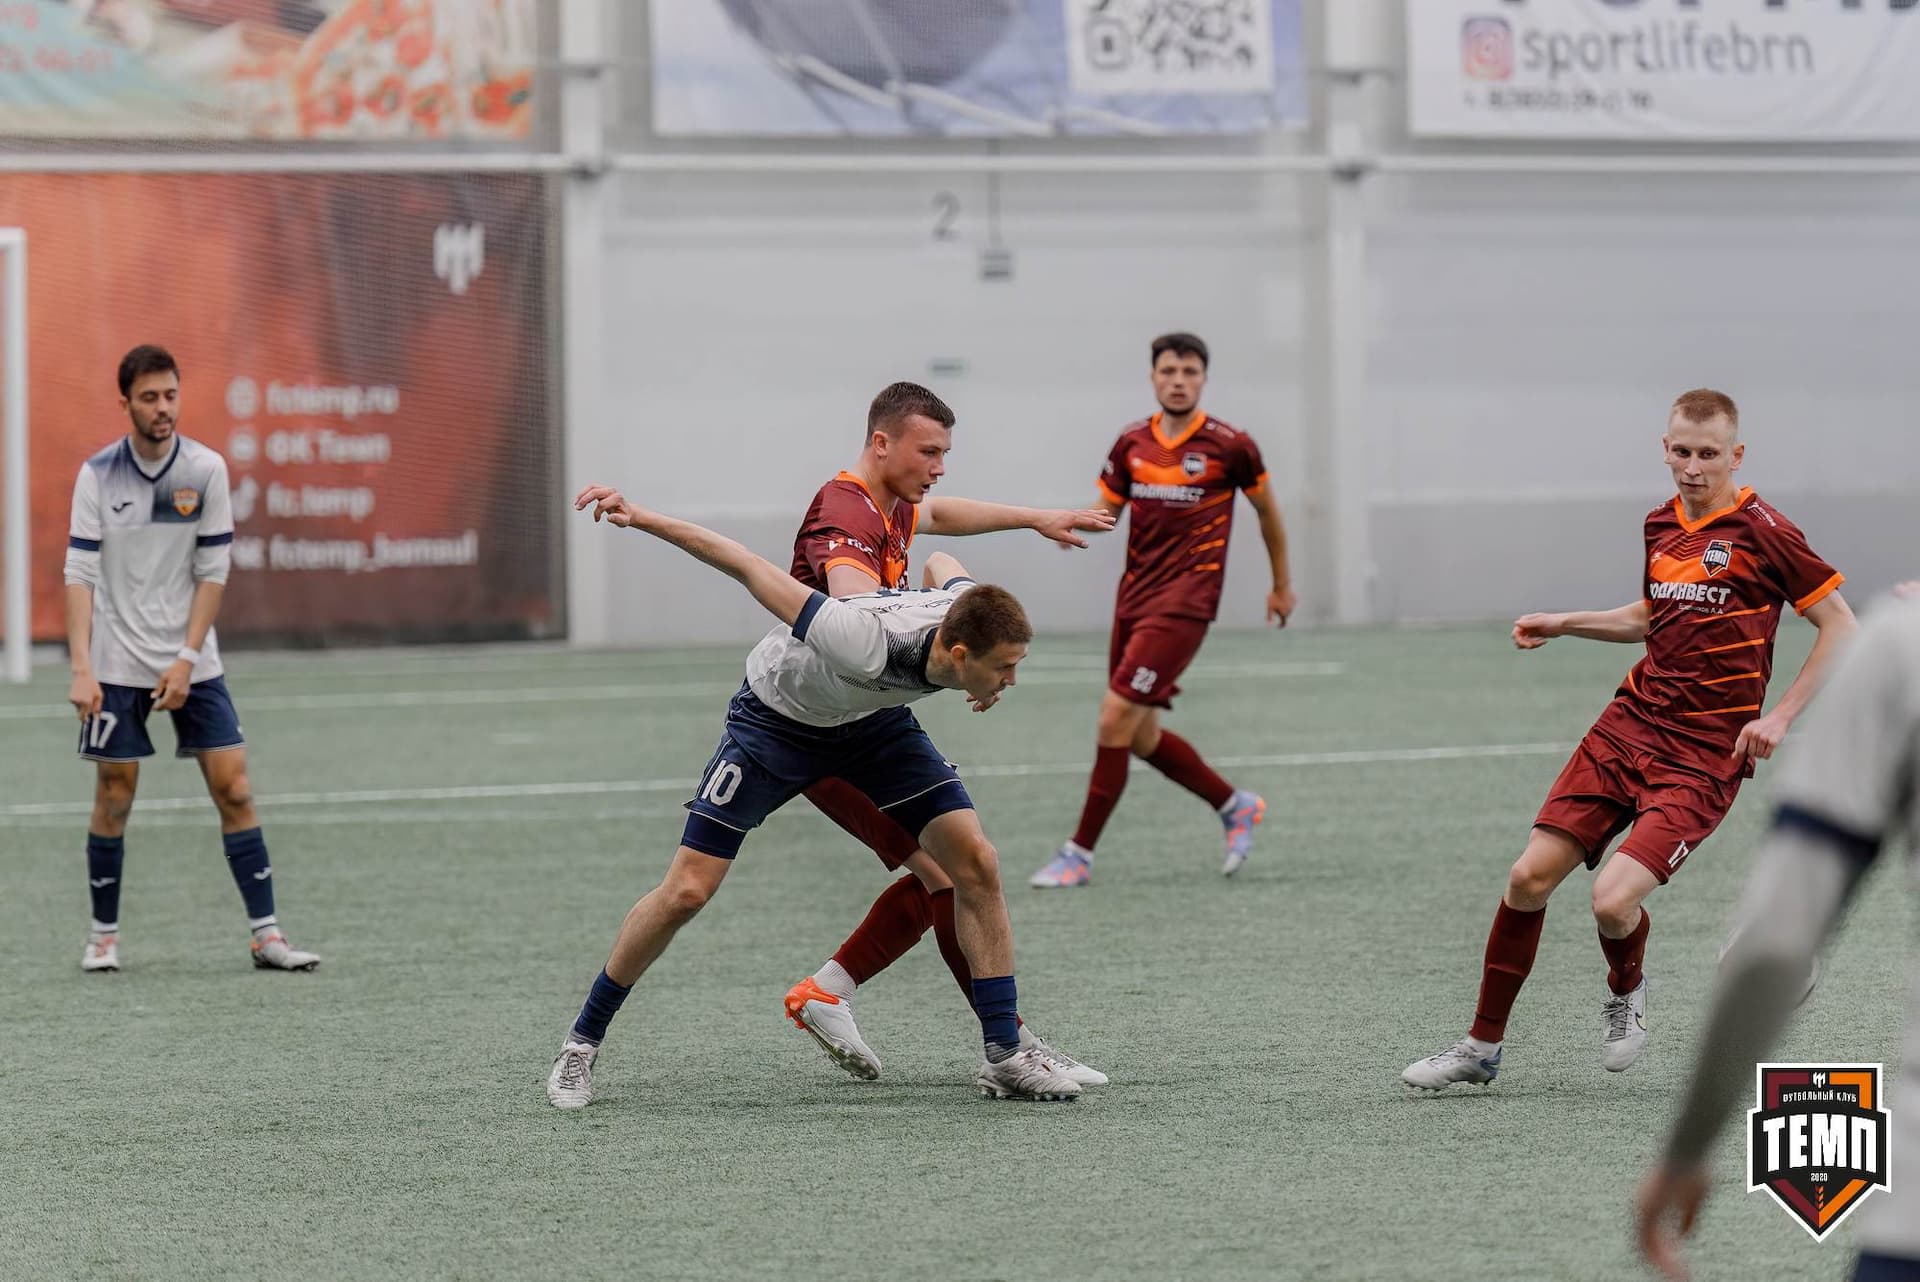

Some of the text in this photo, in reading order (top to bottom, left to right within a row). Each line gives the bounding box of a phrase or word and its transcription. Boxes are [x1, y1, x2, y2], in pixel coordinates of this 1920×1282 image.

[1521, 18, 1816, 79] sportlifebrn
[90, 710, 118, 749] 17
[701, 759, 743, 806] 10
